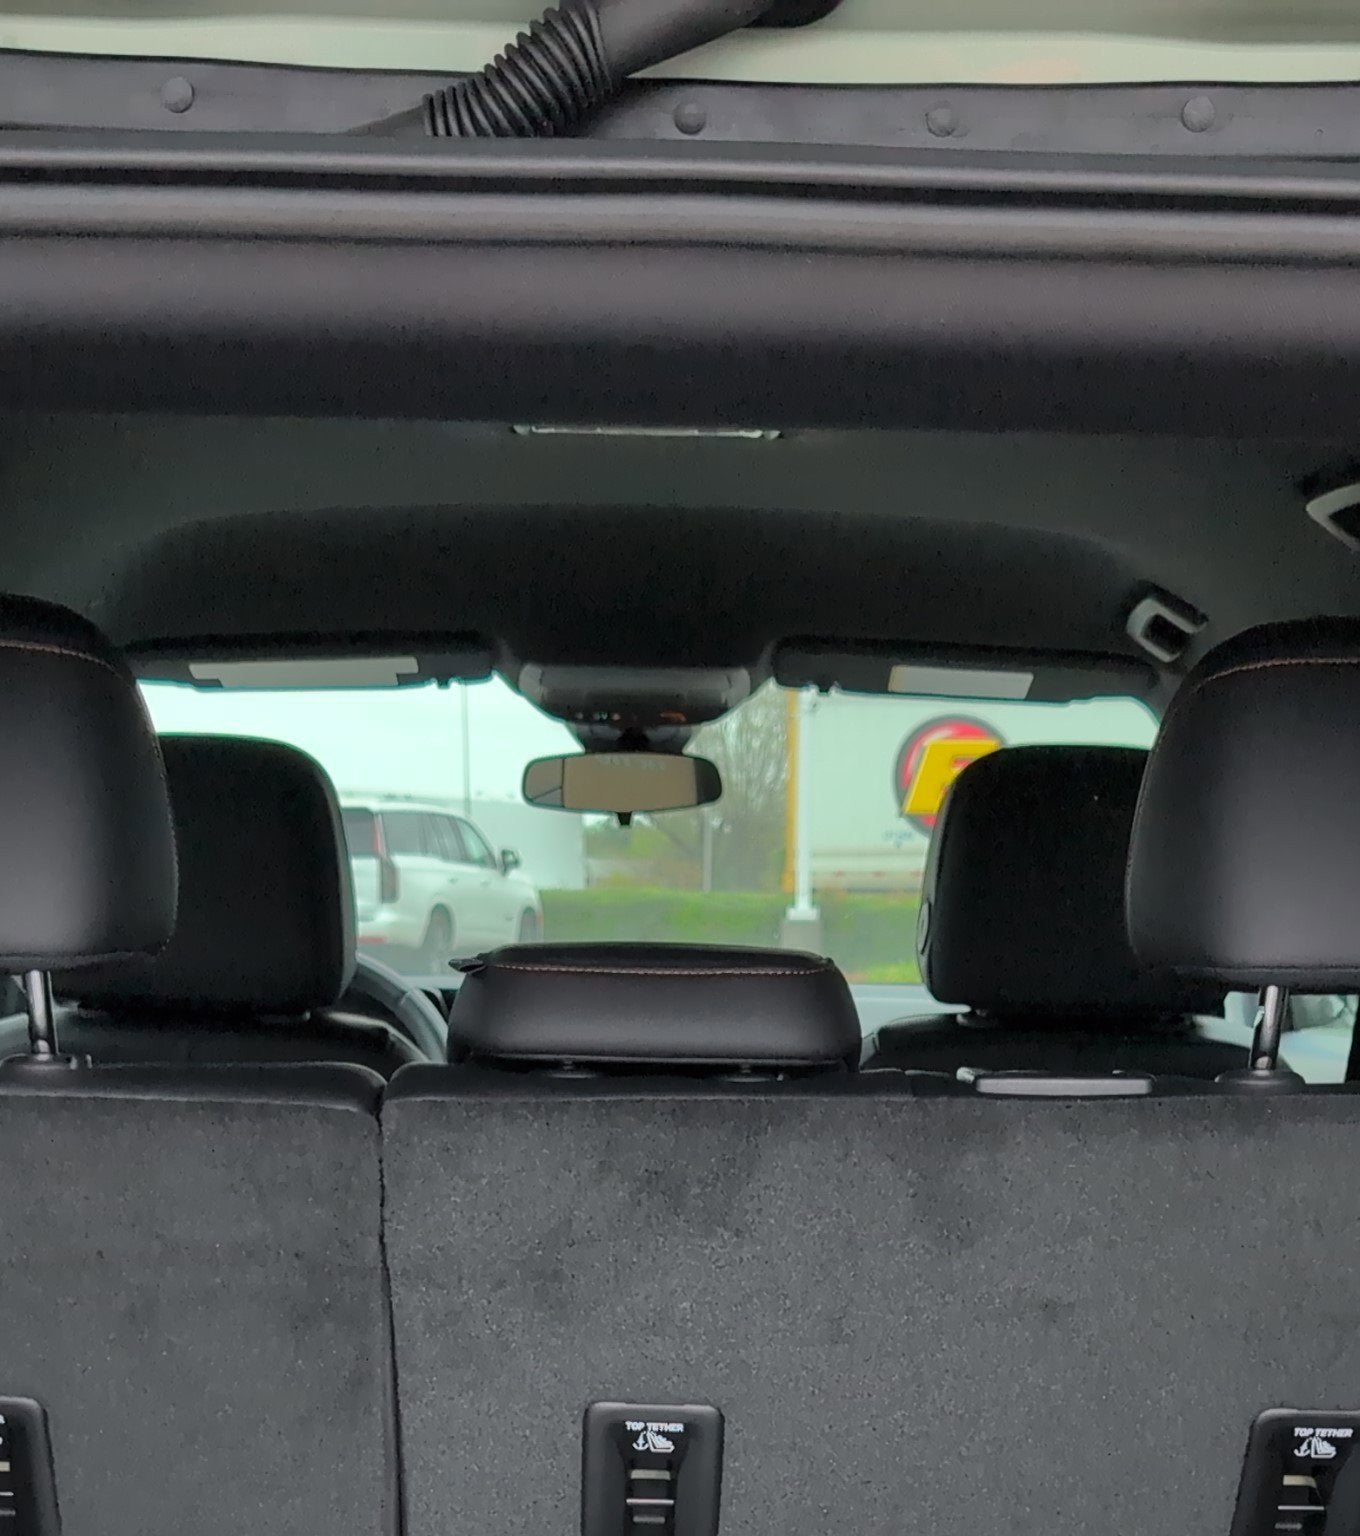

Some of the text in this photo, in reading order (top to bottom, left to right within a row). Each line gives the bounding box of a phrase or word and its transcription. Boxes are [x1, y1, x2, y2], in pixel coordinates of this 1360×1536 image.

[625, 1421, 684, 1432] TOP TETHER
[1294, 1428, 1353, 1438] TOP TETHER
